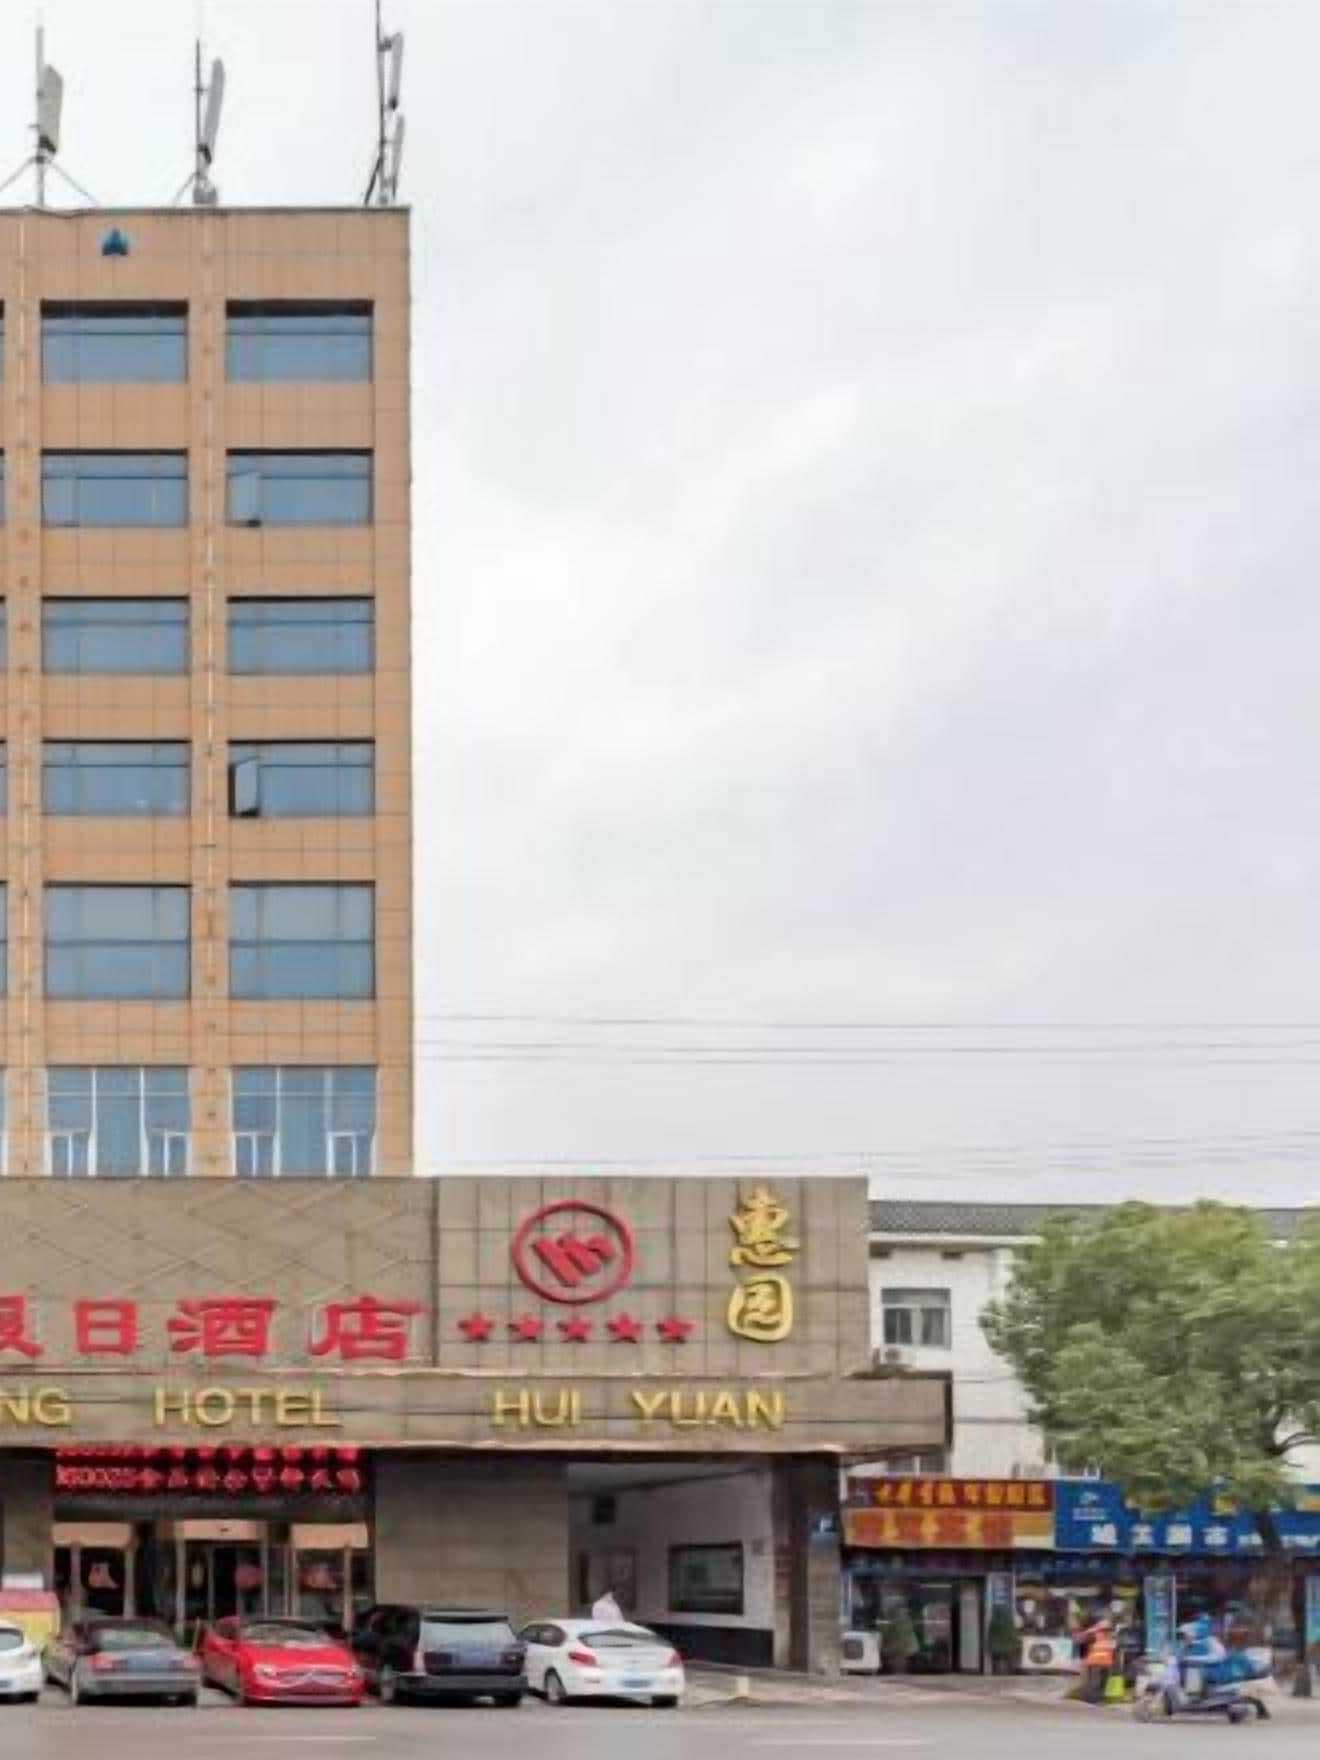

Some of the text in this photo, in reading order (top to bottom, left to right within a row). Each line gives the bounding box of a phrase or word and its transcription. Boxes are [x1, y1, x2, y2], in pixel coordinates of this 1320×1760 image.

[728, 1184, 801, 1342] 惠园
[154, 1385, 343, 1427] HOTEL
[493, 1387, 783, 1429] HUI YUAN
